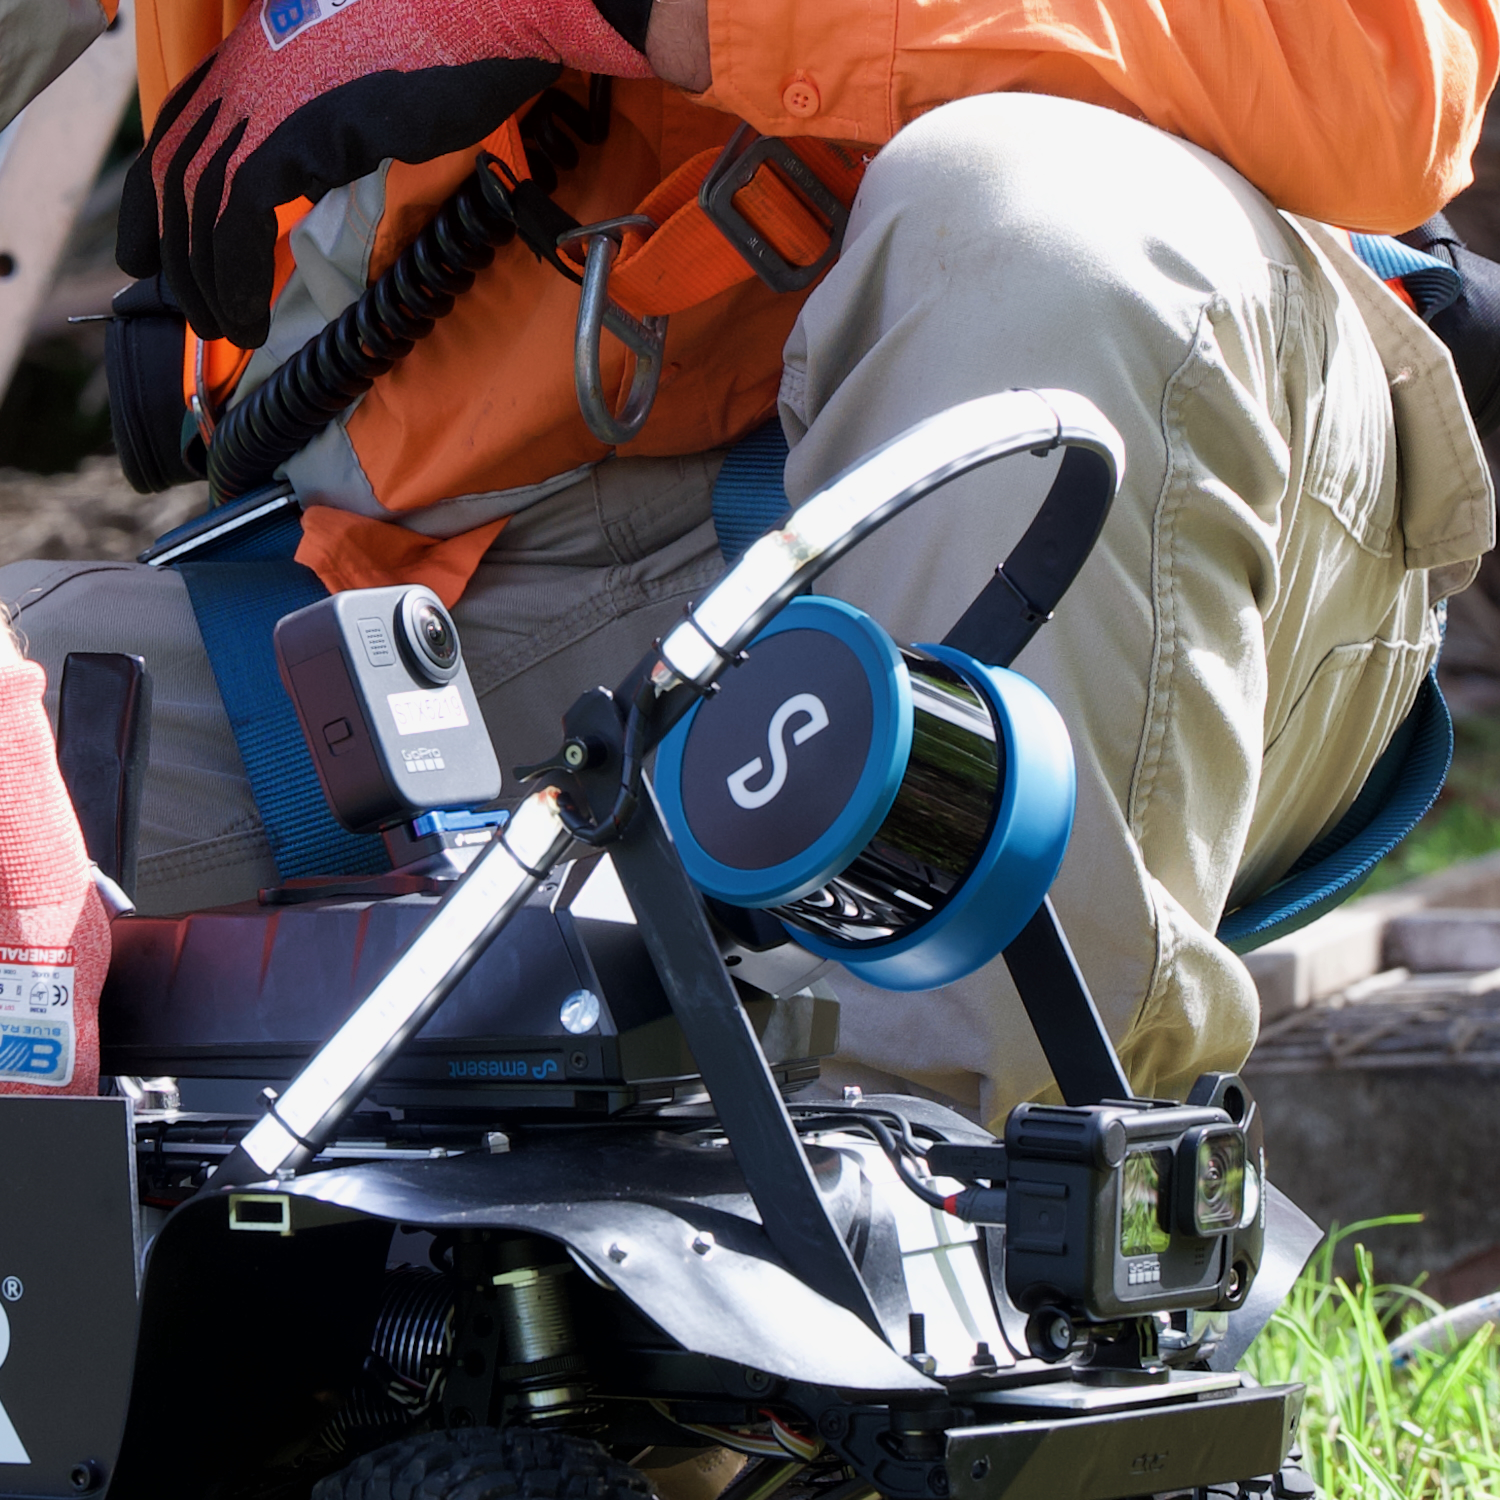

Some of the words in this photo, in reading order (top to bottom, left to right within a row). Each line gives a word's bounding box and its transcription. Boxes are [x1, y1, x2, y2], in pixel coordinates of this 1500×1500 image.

[393, 695, 463, 726] STX5219
[401, 747, 441, 761] GoPro
[22, 1025, 62, 1037] BLUE
[448, 1060, 528, 1078] emesent
[1128, 1260, 1161, 1274] GoPro
